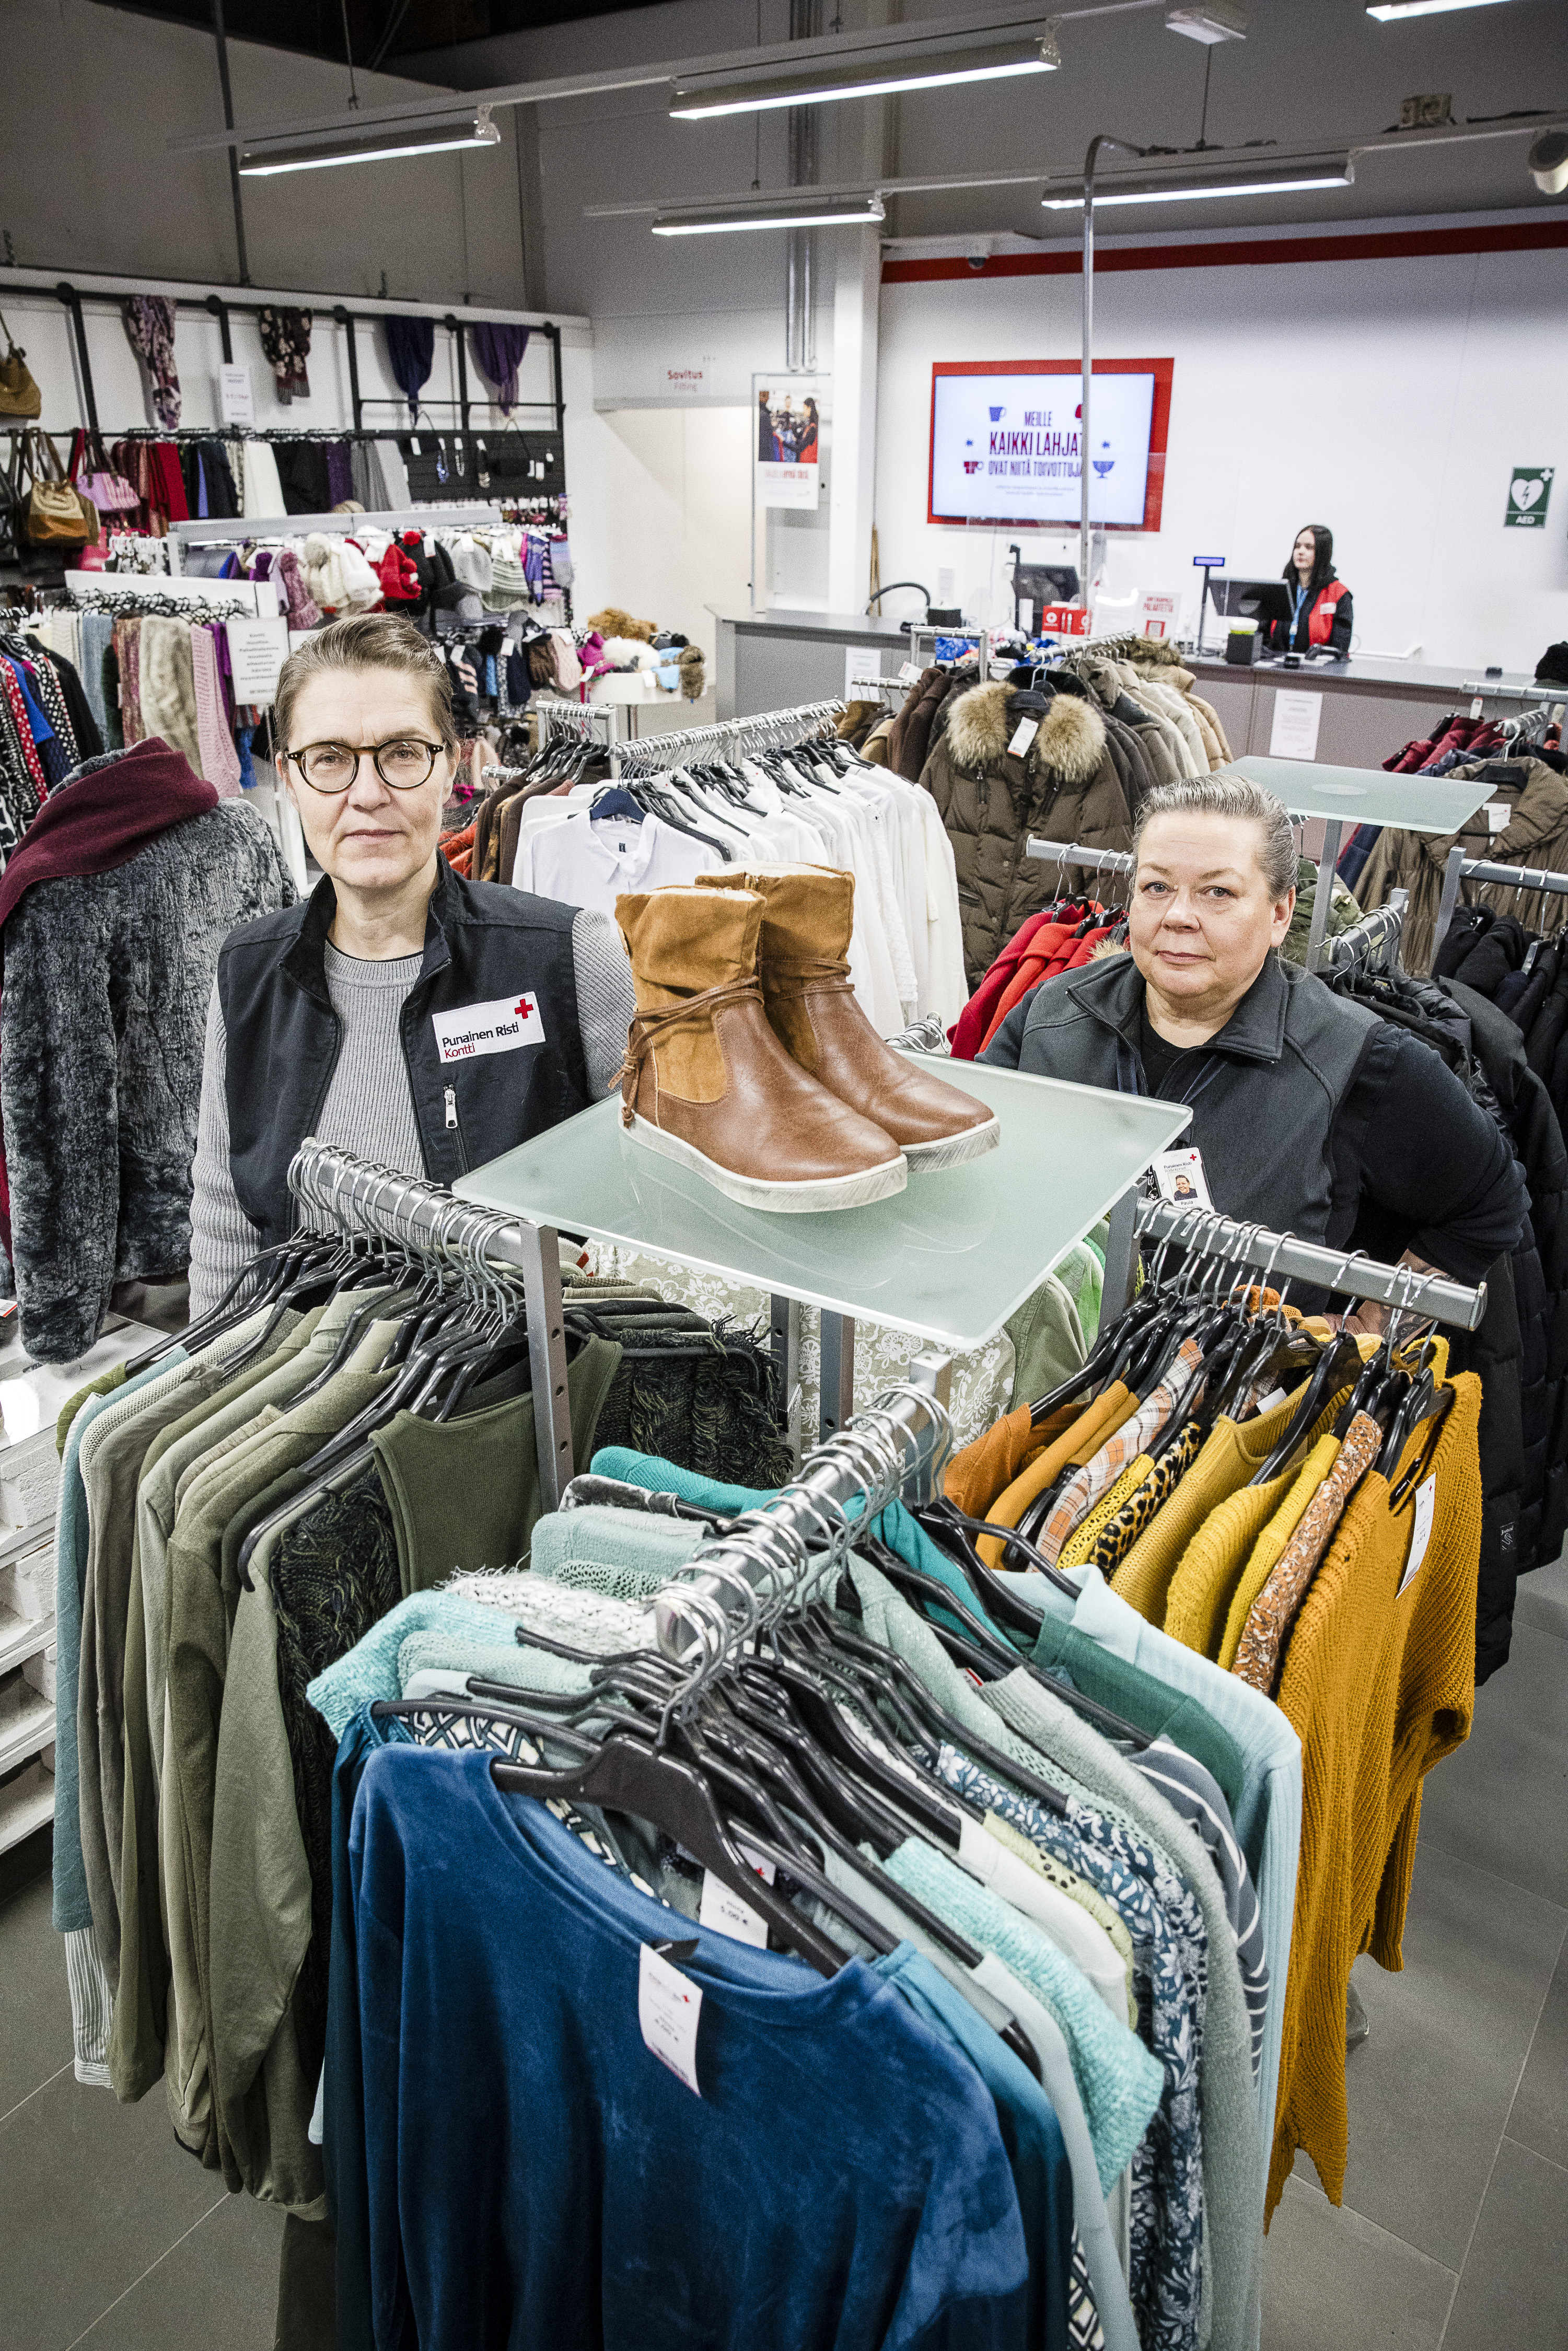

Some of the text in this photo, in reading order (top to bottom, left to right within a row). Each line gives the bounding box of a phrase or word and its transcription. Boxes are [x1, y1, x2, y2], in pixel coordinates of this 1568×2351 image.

[667, 369, 703, 380] Sovitus
[1025, 411, 1052, 426] MEILLE
[990, 432, 1033, 455] KAIKKI
[989, 461, 1008, 475] OVAT
[1515, 515, 1535, 525] AED
[442, 1022, 519, 1048] Punainen Risti
[445, 1042, 475, 1058] Kontti
